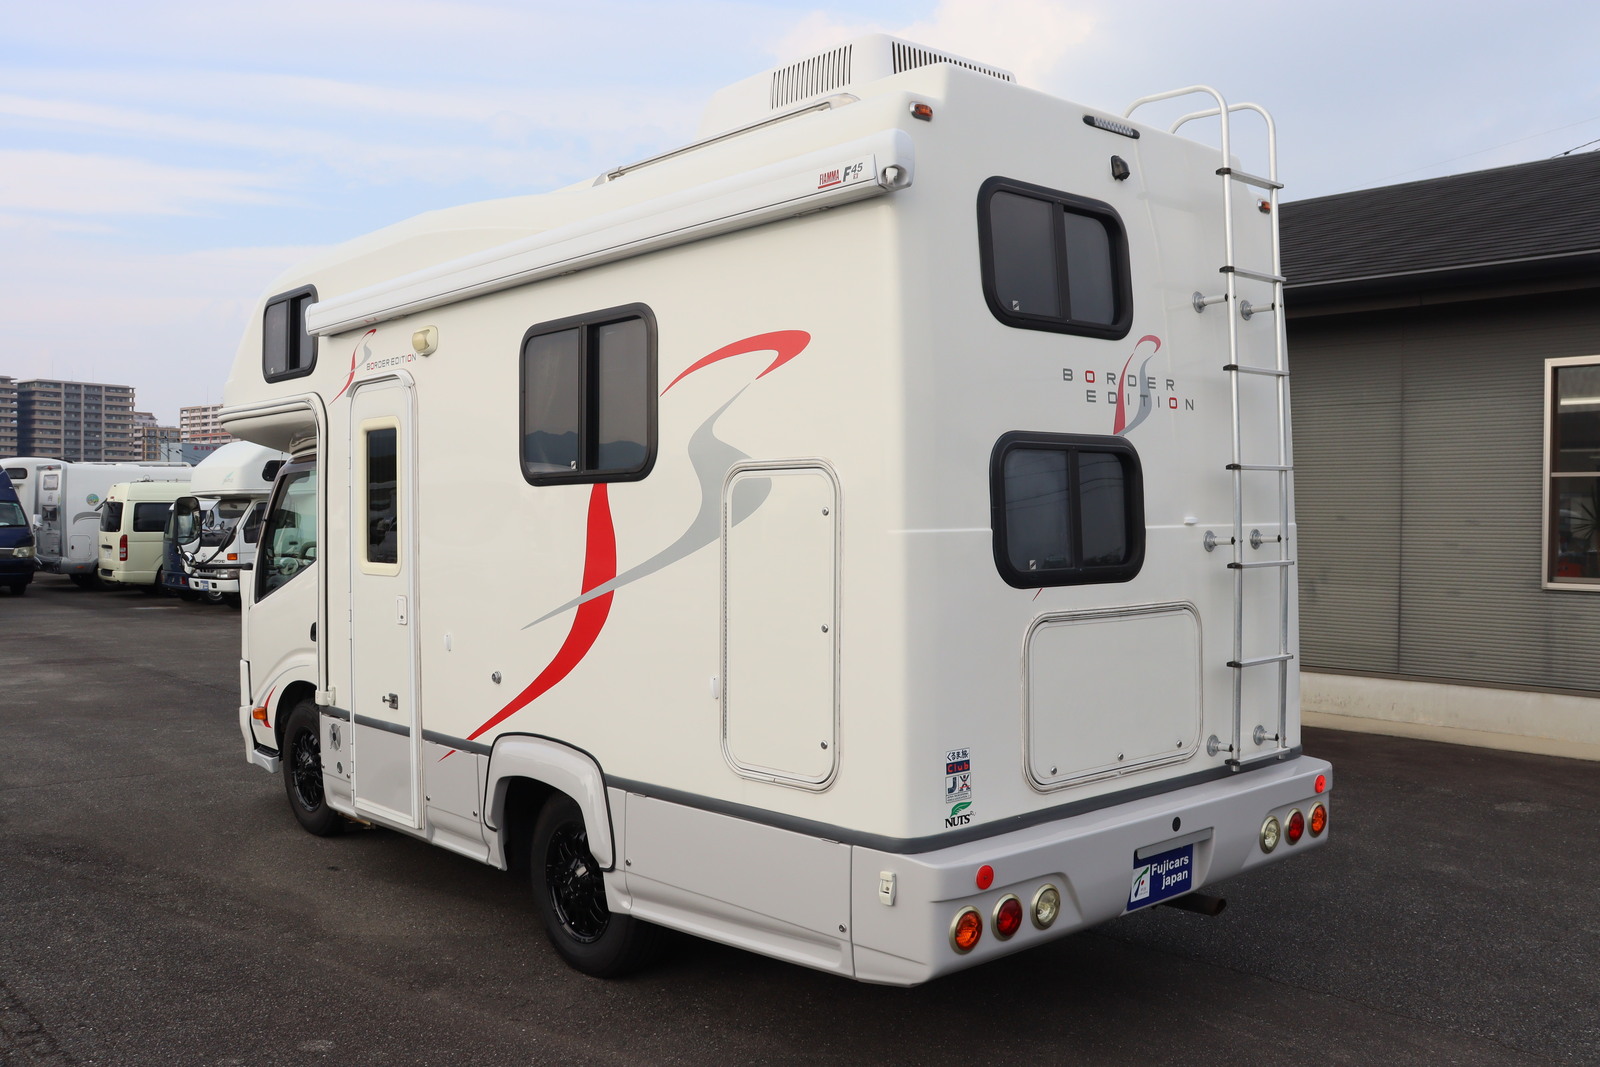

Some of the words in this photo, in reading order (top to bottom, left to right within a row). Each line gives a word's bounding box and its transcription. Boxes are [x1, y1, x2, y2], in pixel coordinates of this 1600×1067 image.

[819, 169, 840, 185] FIAMMA
[366, 358, 390, 371] BORDER
[390, 353, 417, 366] EDITION
[1062, 367, 1175, 391] BORDER
[1086, 389, 1194, 411] EDITION
[946, 749, 969, 762] くるま旅
[947, 762, 969, 774] Club
[945, 814, 971, 829] NUTS
[1152, 856, 1188, 876] Fujicars
[1161, 870, 1188, 890] japan
